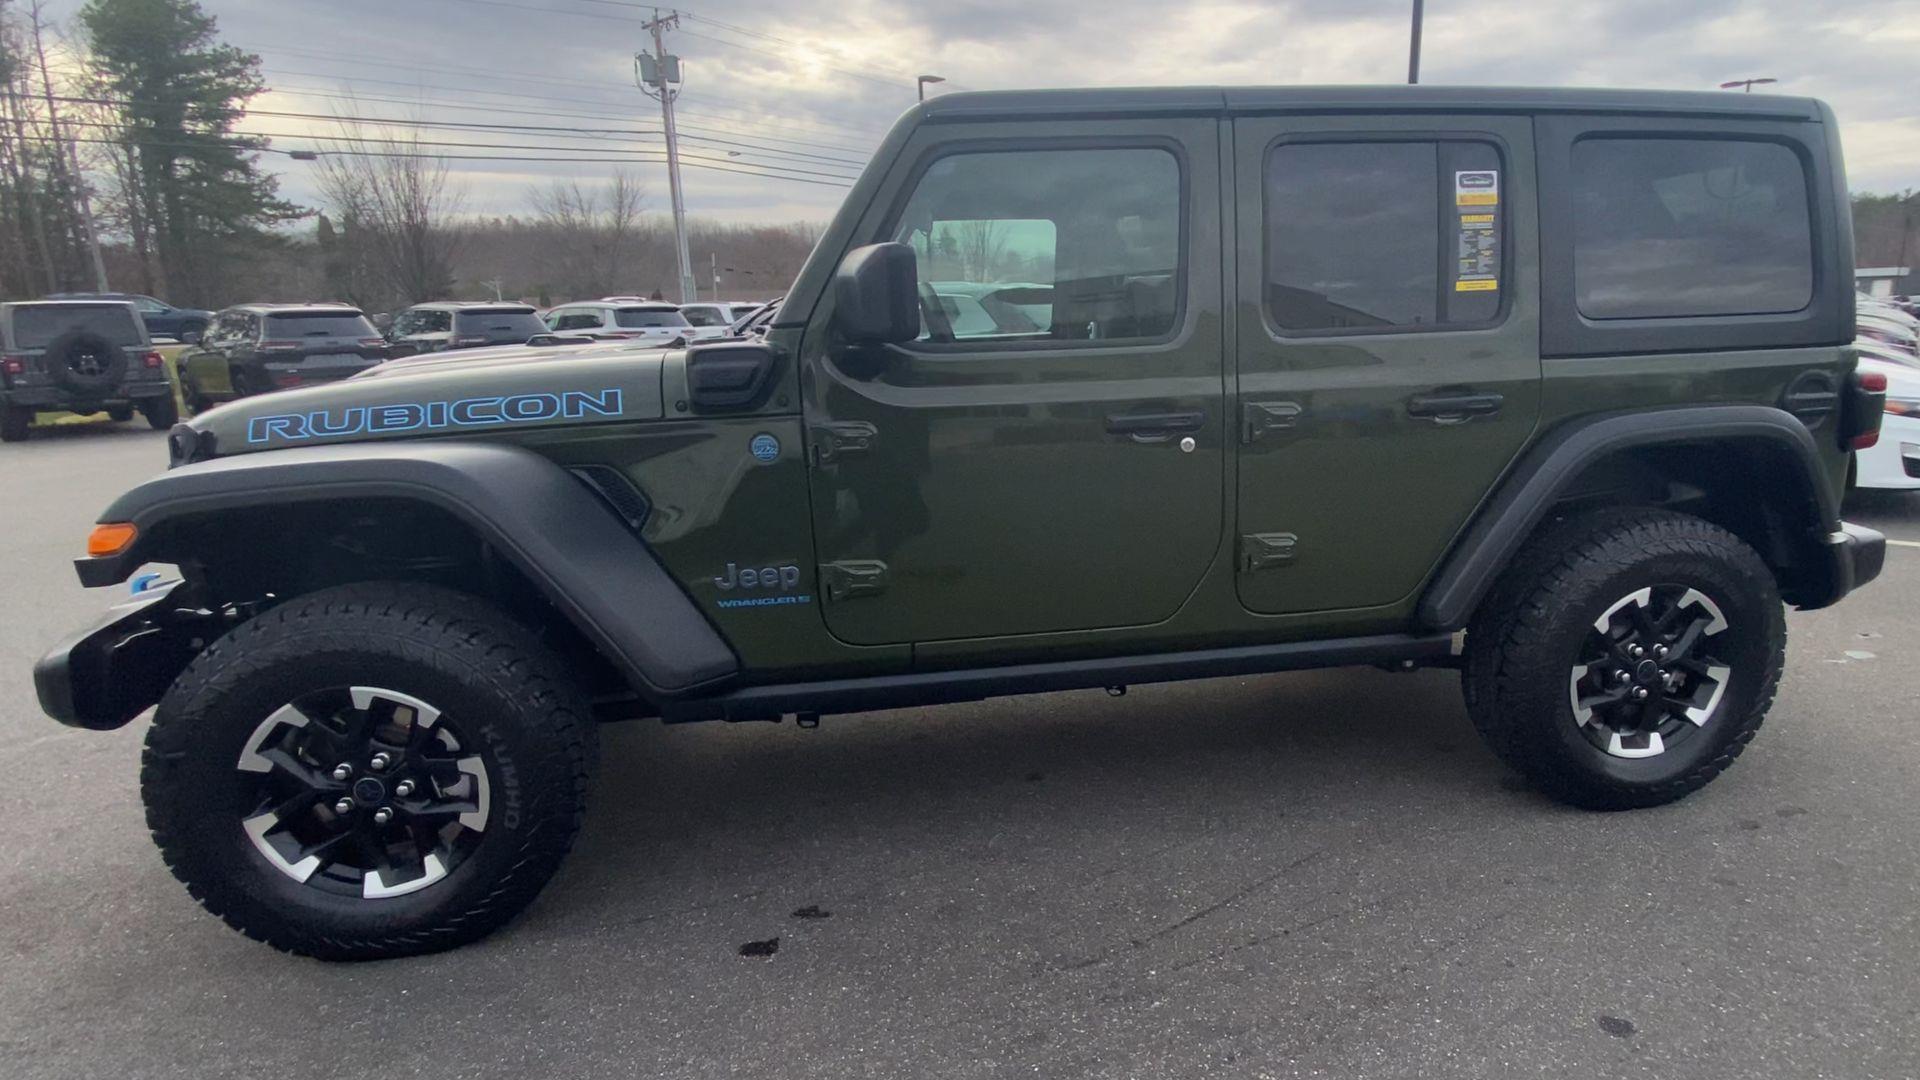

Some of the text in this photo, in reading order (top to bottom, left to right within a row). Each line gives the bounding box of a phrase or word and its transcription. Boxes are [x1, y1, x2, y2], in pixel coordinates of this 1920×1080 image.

[248, 388, 624, 443] RUBICON
[714, 563, 800, 591] Jeep
[717, 596, 797, 608] WRANGLER
